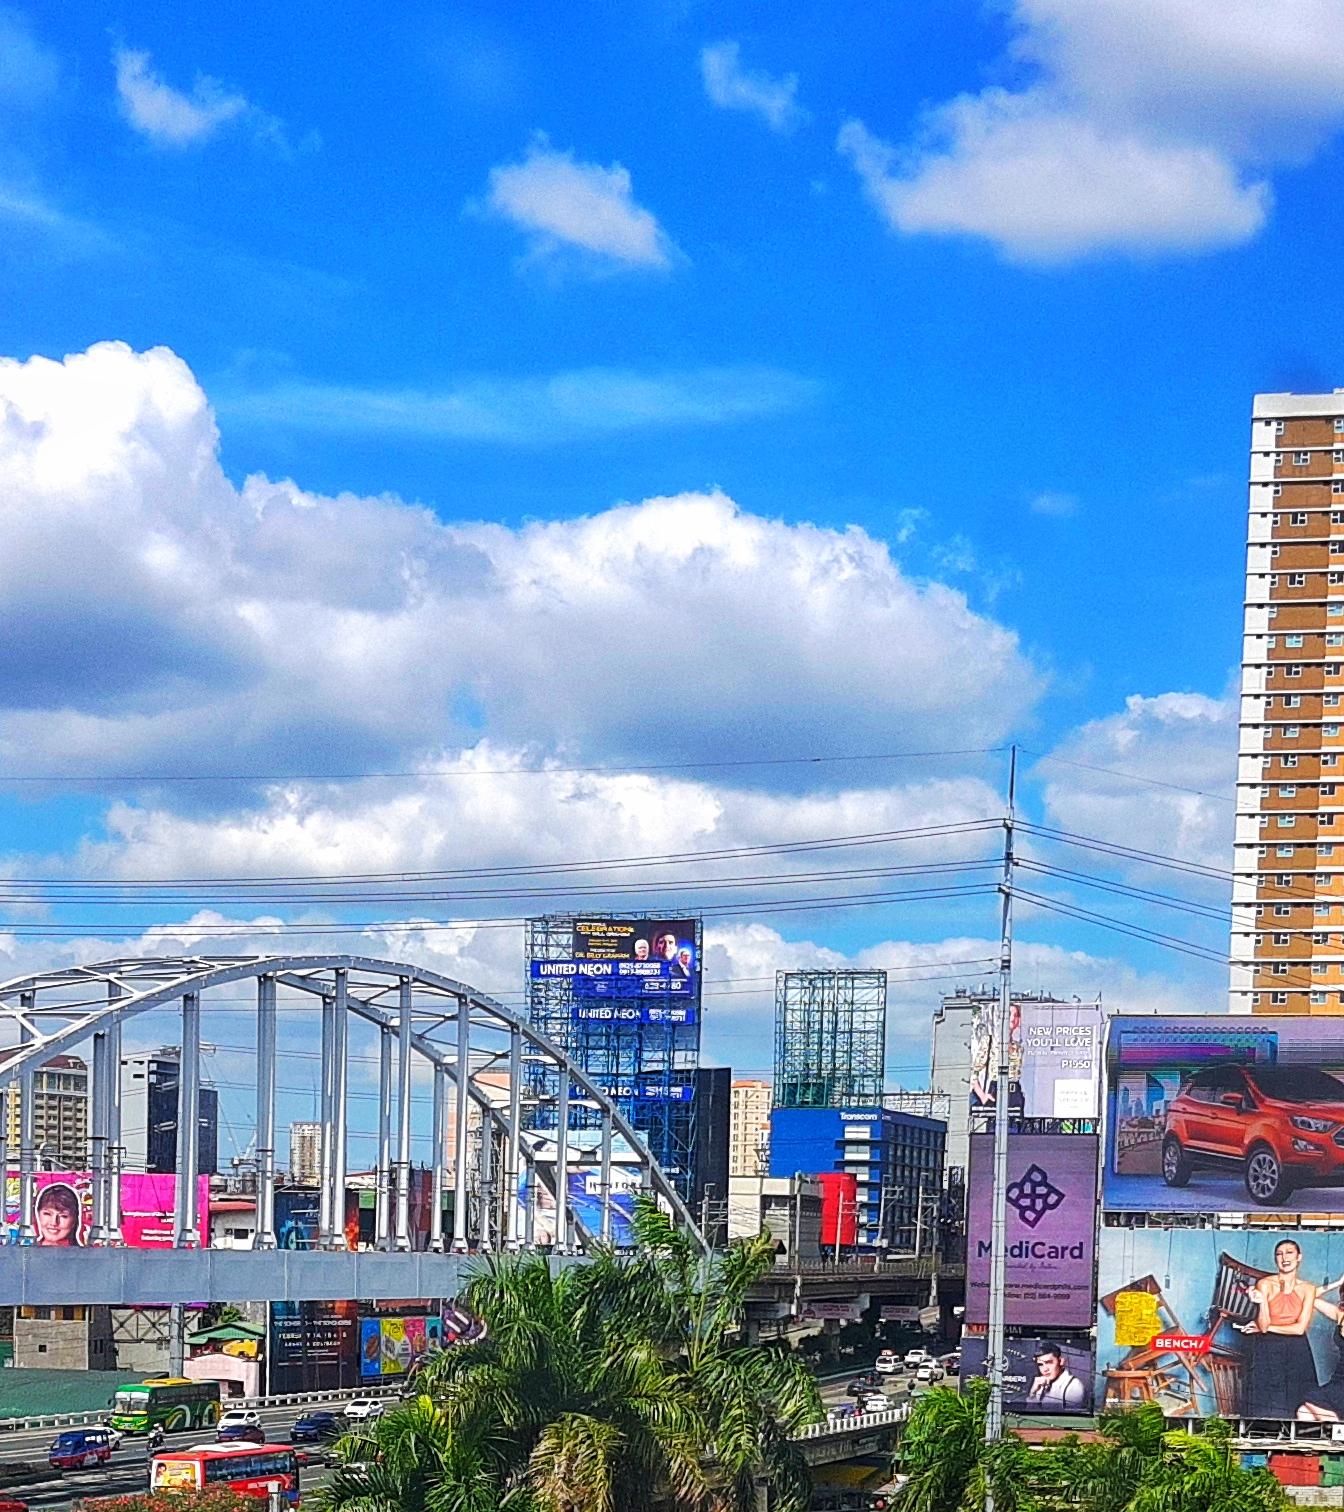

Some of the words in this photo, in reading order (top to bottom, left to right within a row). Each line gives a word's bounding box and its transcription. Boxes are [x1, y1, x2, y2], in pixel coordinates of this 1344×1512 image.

[540, 963, 576, 975] UNITED
[579, 963, 612, 976] NEON
[1029, 1026, 1053, 1036] NEW
[1056, 1026, 1092, 1036] PRICES
[1064, 1038, 1092, 1047] LOVE
[840, 1111, 877, 1120] Transcom
[977, 1240, 1084, 1260] MdiCard
